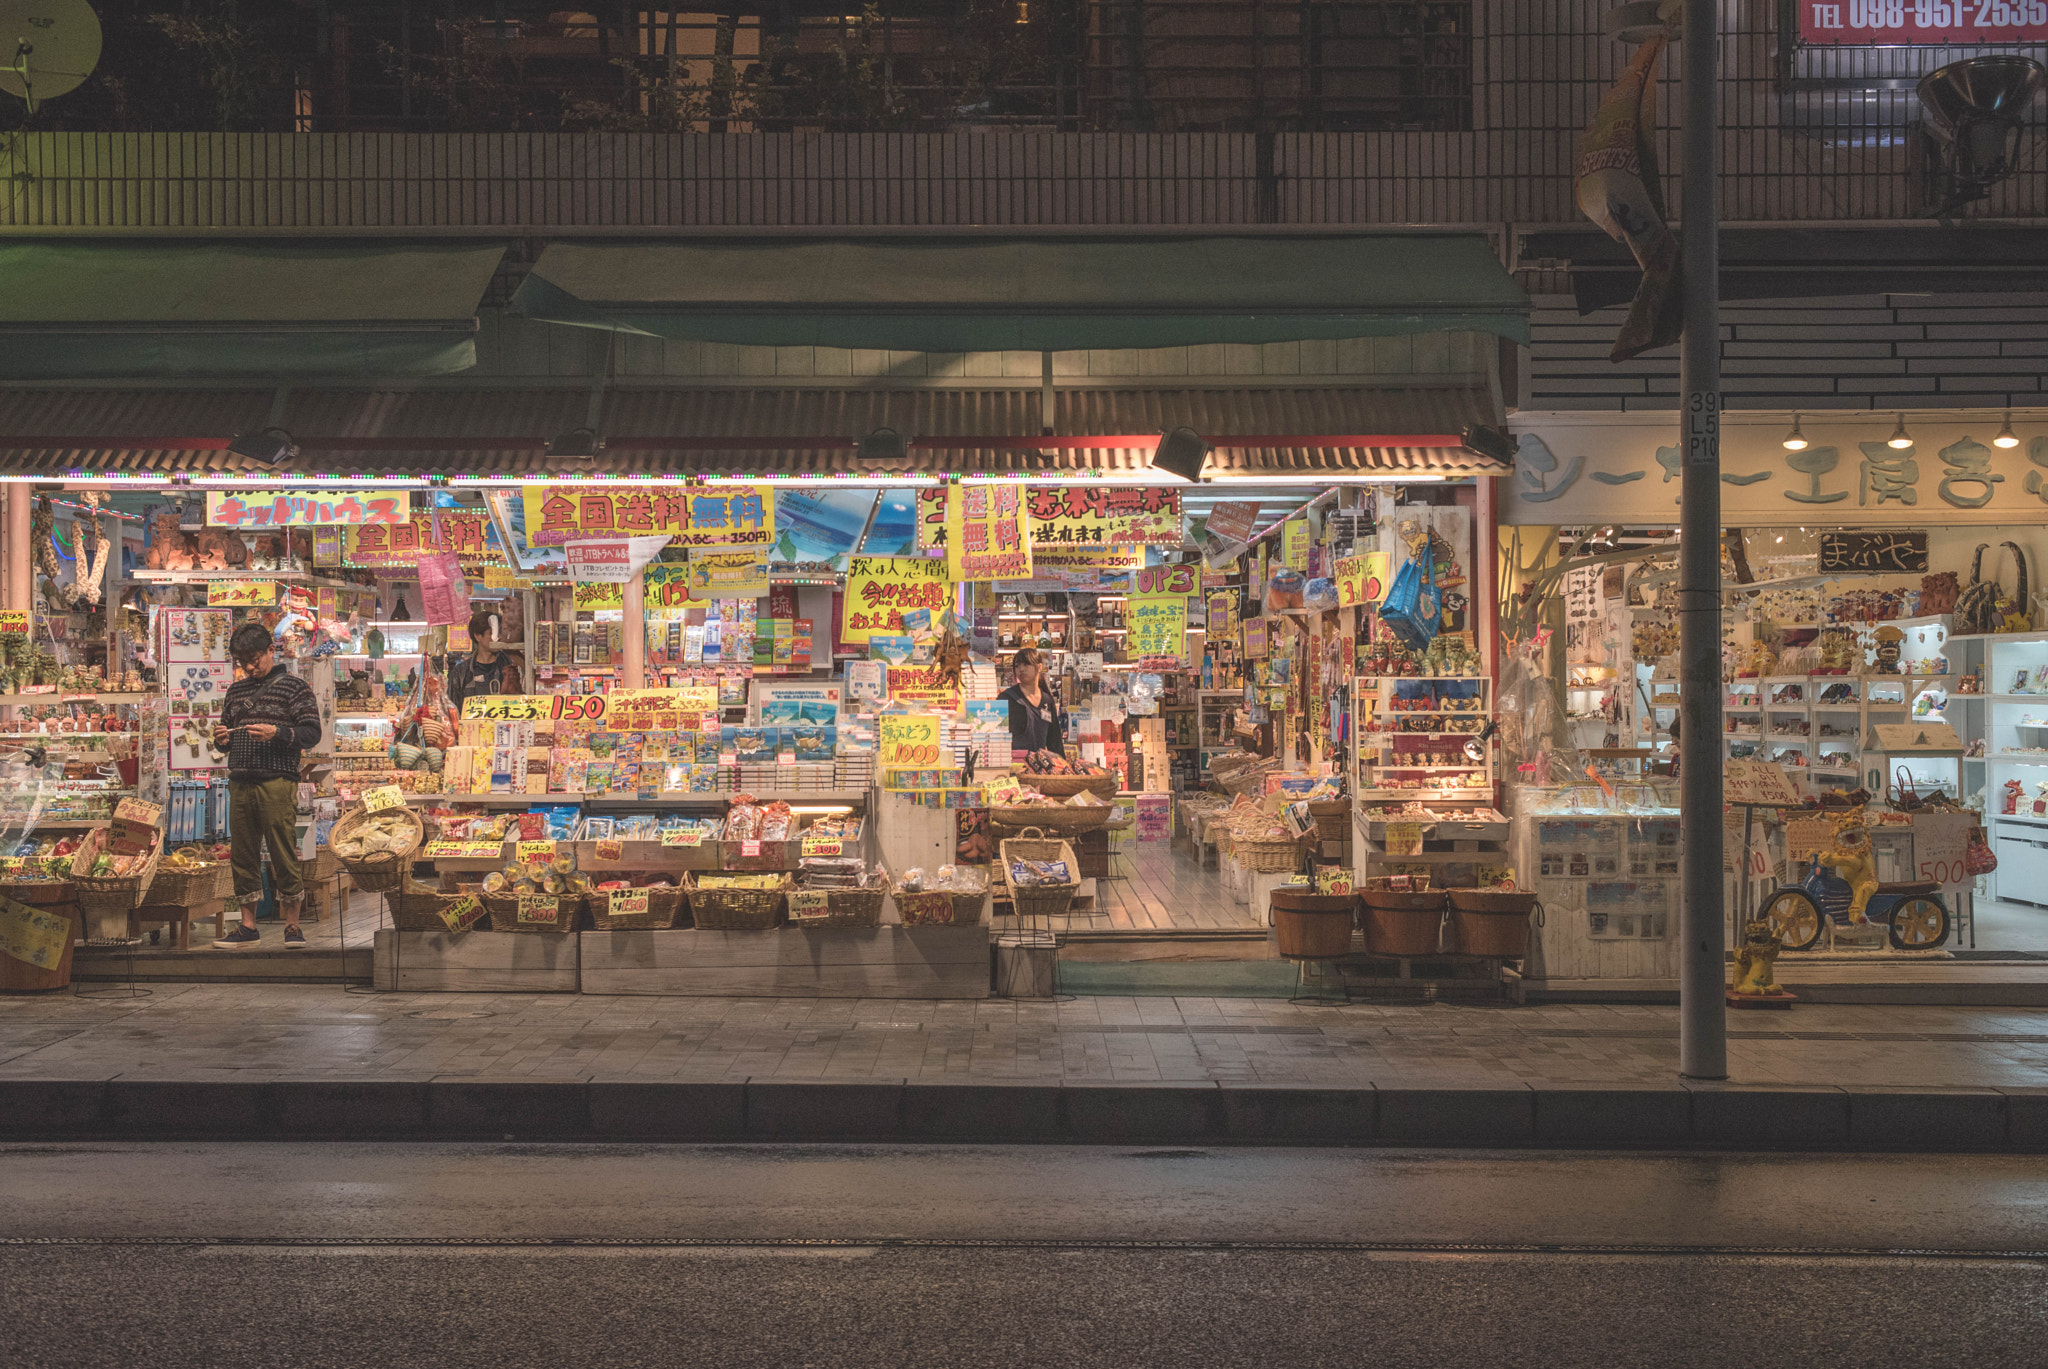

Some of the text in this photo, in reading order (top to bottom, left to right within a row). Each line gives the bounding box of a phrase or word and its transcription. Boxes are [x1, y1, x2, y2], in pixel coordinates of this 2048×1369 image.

[1812, 0, 2047, 28] TEL 098-951-2535
[1690, 392, 1716, 412] 39
[1691, 414, 1716, 434] L5
[1690, 437, 1717, 456] P10
[213, 497, 405, 525] キッドハウス
[540, 494, 766, 530] 全国送料無料
[1824, 534, 1927, 569] まぶやー
[1126, 565, 1195, 594] OP3
[550, 695, 605, 720] 150
[895, 743, 939, 763] 1000
[1920, 861, 1965, 883] 500
